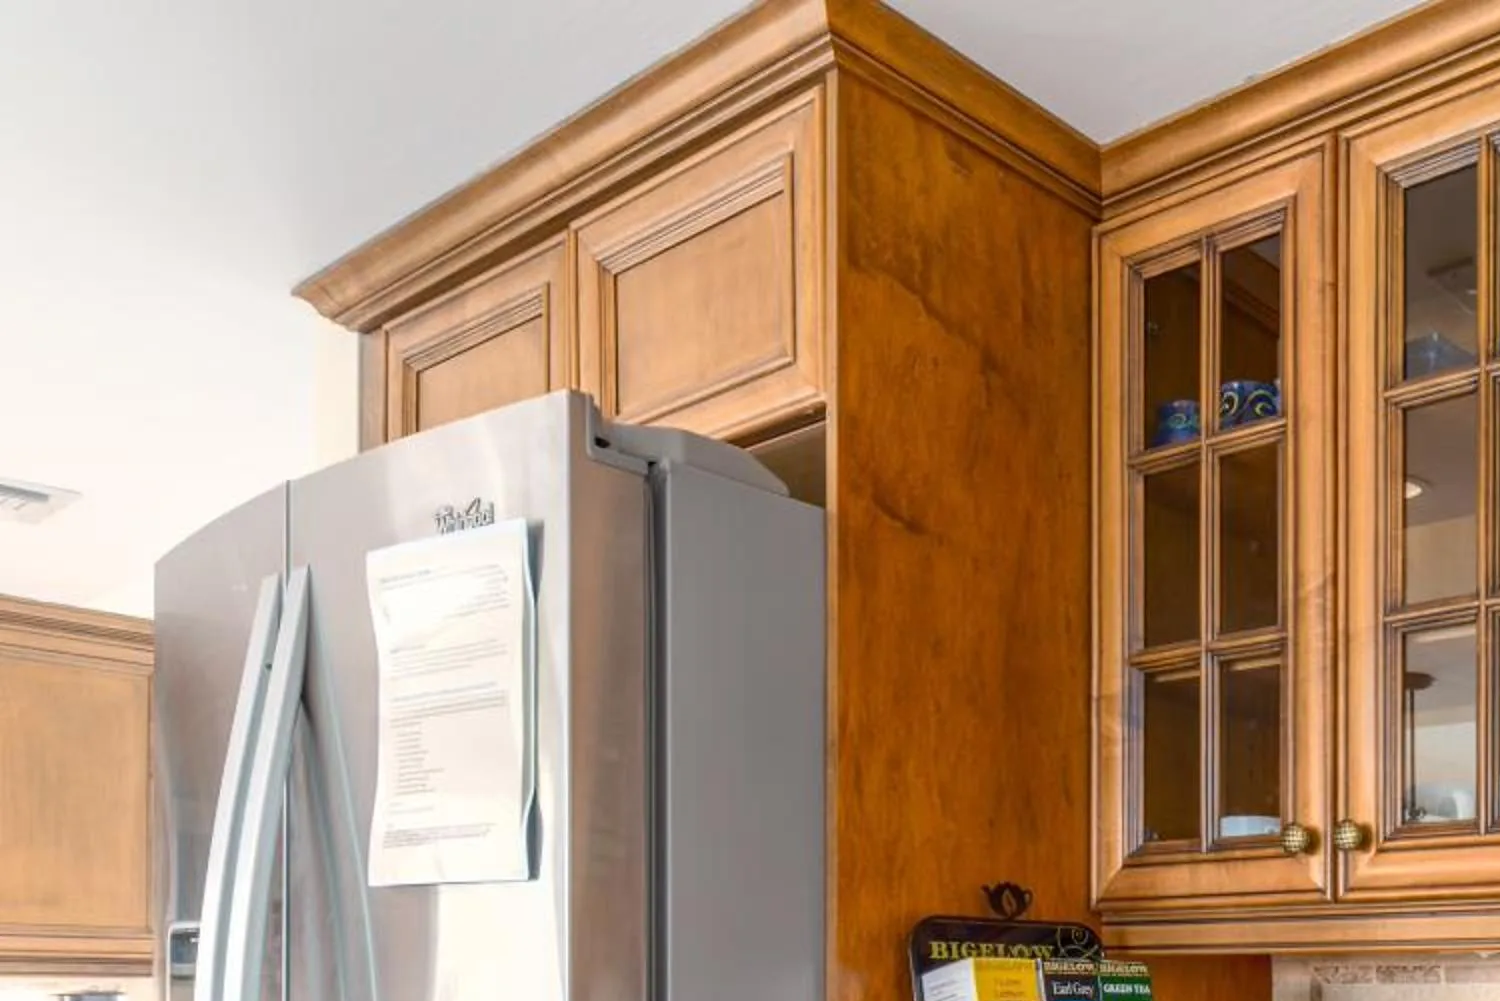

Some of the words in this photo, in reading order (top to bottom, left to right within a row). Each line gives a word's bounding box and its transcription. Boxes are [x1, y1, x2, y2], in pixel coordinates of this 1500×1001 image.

[929, 941, 1053, 960] BIGELOW
[1052, 981, 1073, 995] Earl
[1073, 981, 1094, 997] Grey
[1103, 983, 1132, 993] GREEN
[1133, 983, 1151, 993] TEA
